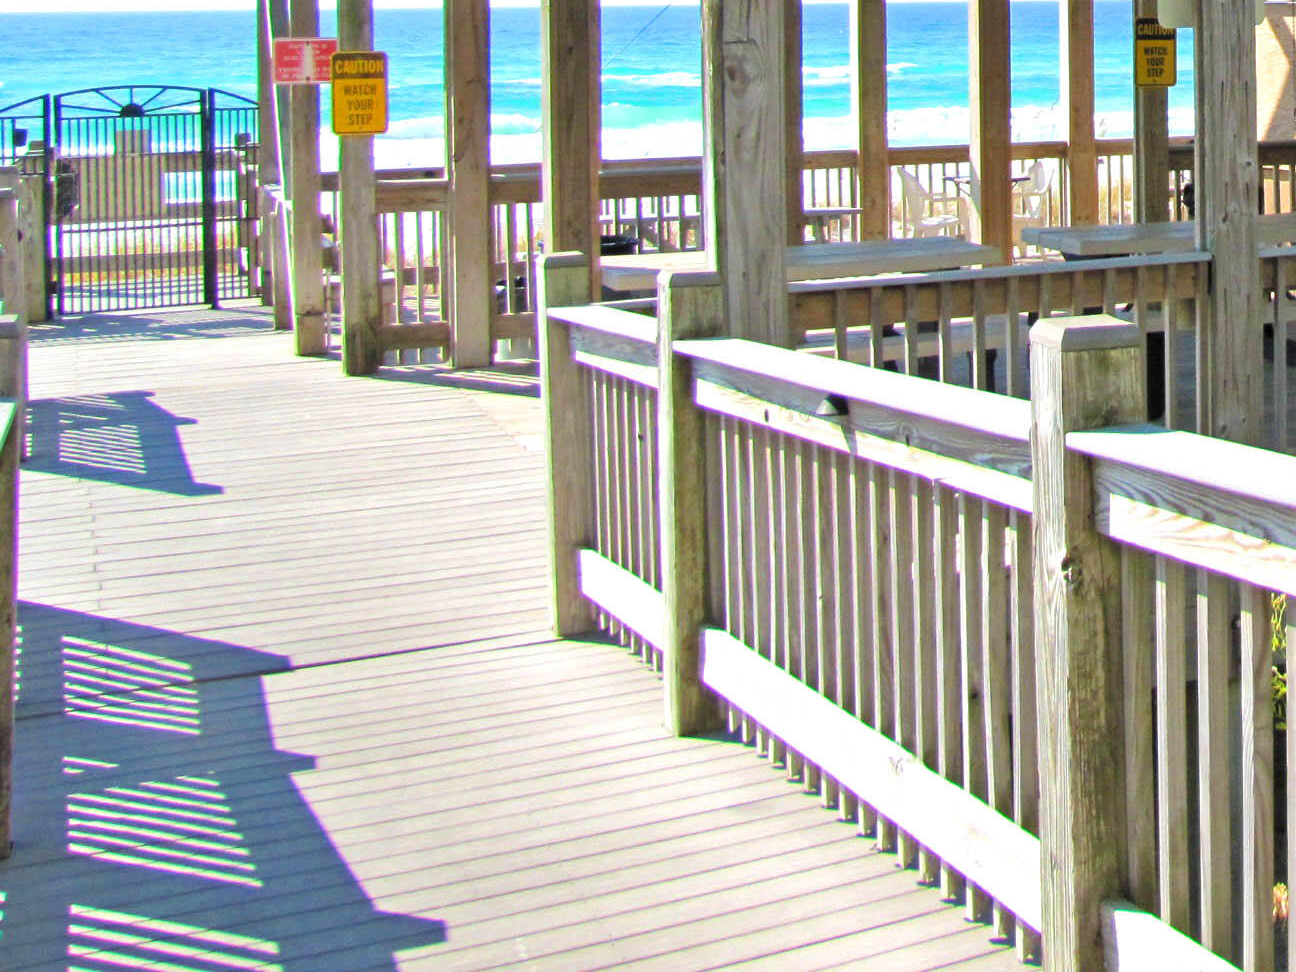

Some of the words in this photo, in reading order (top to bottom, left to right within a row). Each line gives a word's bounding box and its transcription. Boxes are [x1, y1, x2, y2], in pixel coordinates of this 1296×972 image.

[335, 59, 384, 74] CAUTION
[344, 84, 377, 96] WATCH
[347, 99, 374, 111] YOUR
[348, 114, 373, 126] STEP
